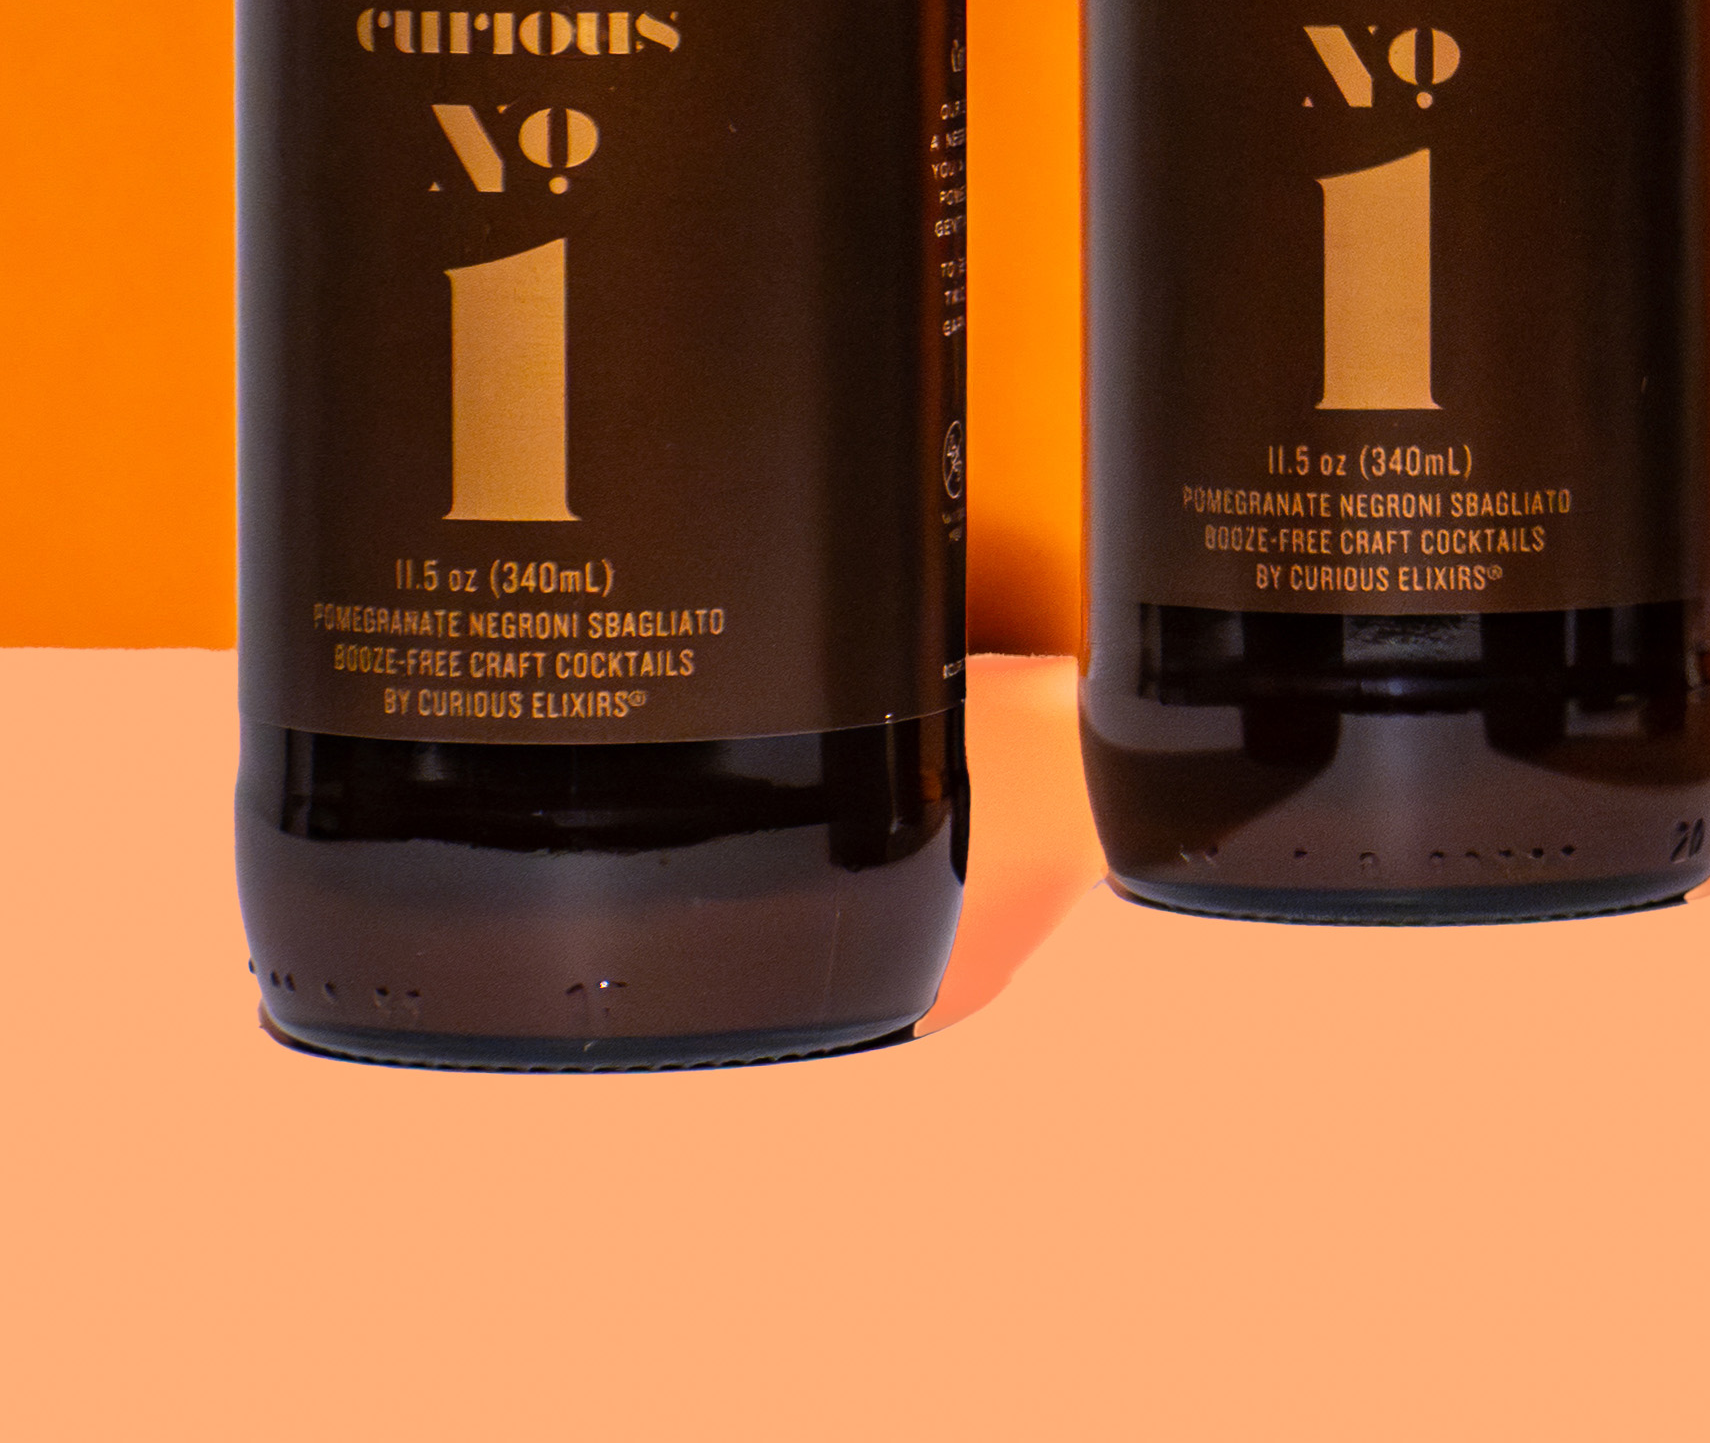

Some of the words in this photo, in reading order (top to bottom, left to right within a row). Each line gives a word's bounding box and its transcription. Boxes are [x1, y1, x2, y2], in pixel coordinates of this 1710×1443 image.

[357, 9, 681, 57] curious
[1315, 147, 1443, 411] 1
[443, 237, 582, 522] 1
[1268, 445, 1309, 476] 11.5
[1319, 453, 1347, 477] oz
[1359, 444, 1473, 481] (340mL)
[1183, 486, 1330, 518] POMEGRANATE
[1340, 493, 1441, 518] NEGRONI
[1451, 489, 1571, 517] SBAGLIATO
[1205, 525, 1331, 554] BOOZE-FREE
[1340, 528, 1411, 555] CRAFT
[1421, 525, 1545, 555] COCKTAILS
[396, 559, 438, 592] 11.5
[448, 569, 477, 593] oz
[489, 558, 615, 598] (340mL)
[1256, 564, 1281, 590] BY
[1290, 565, 1389, 592] CURIOUS
[314, 603, 461, 638] POMEGRANATE
[469, 611, 579, 641] NEGRONI
[587, 607, 725, 639] SBAGLIATO
[335, 644, 461, 677] BOOZE-FREE
[470, 650, 546, 679] CRAFT
[555, 648, 694, 679] COCKTAILS
[384, 688, 410, 715] BY
[418, 689, 522, 719] CURIOUS
